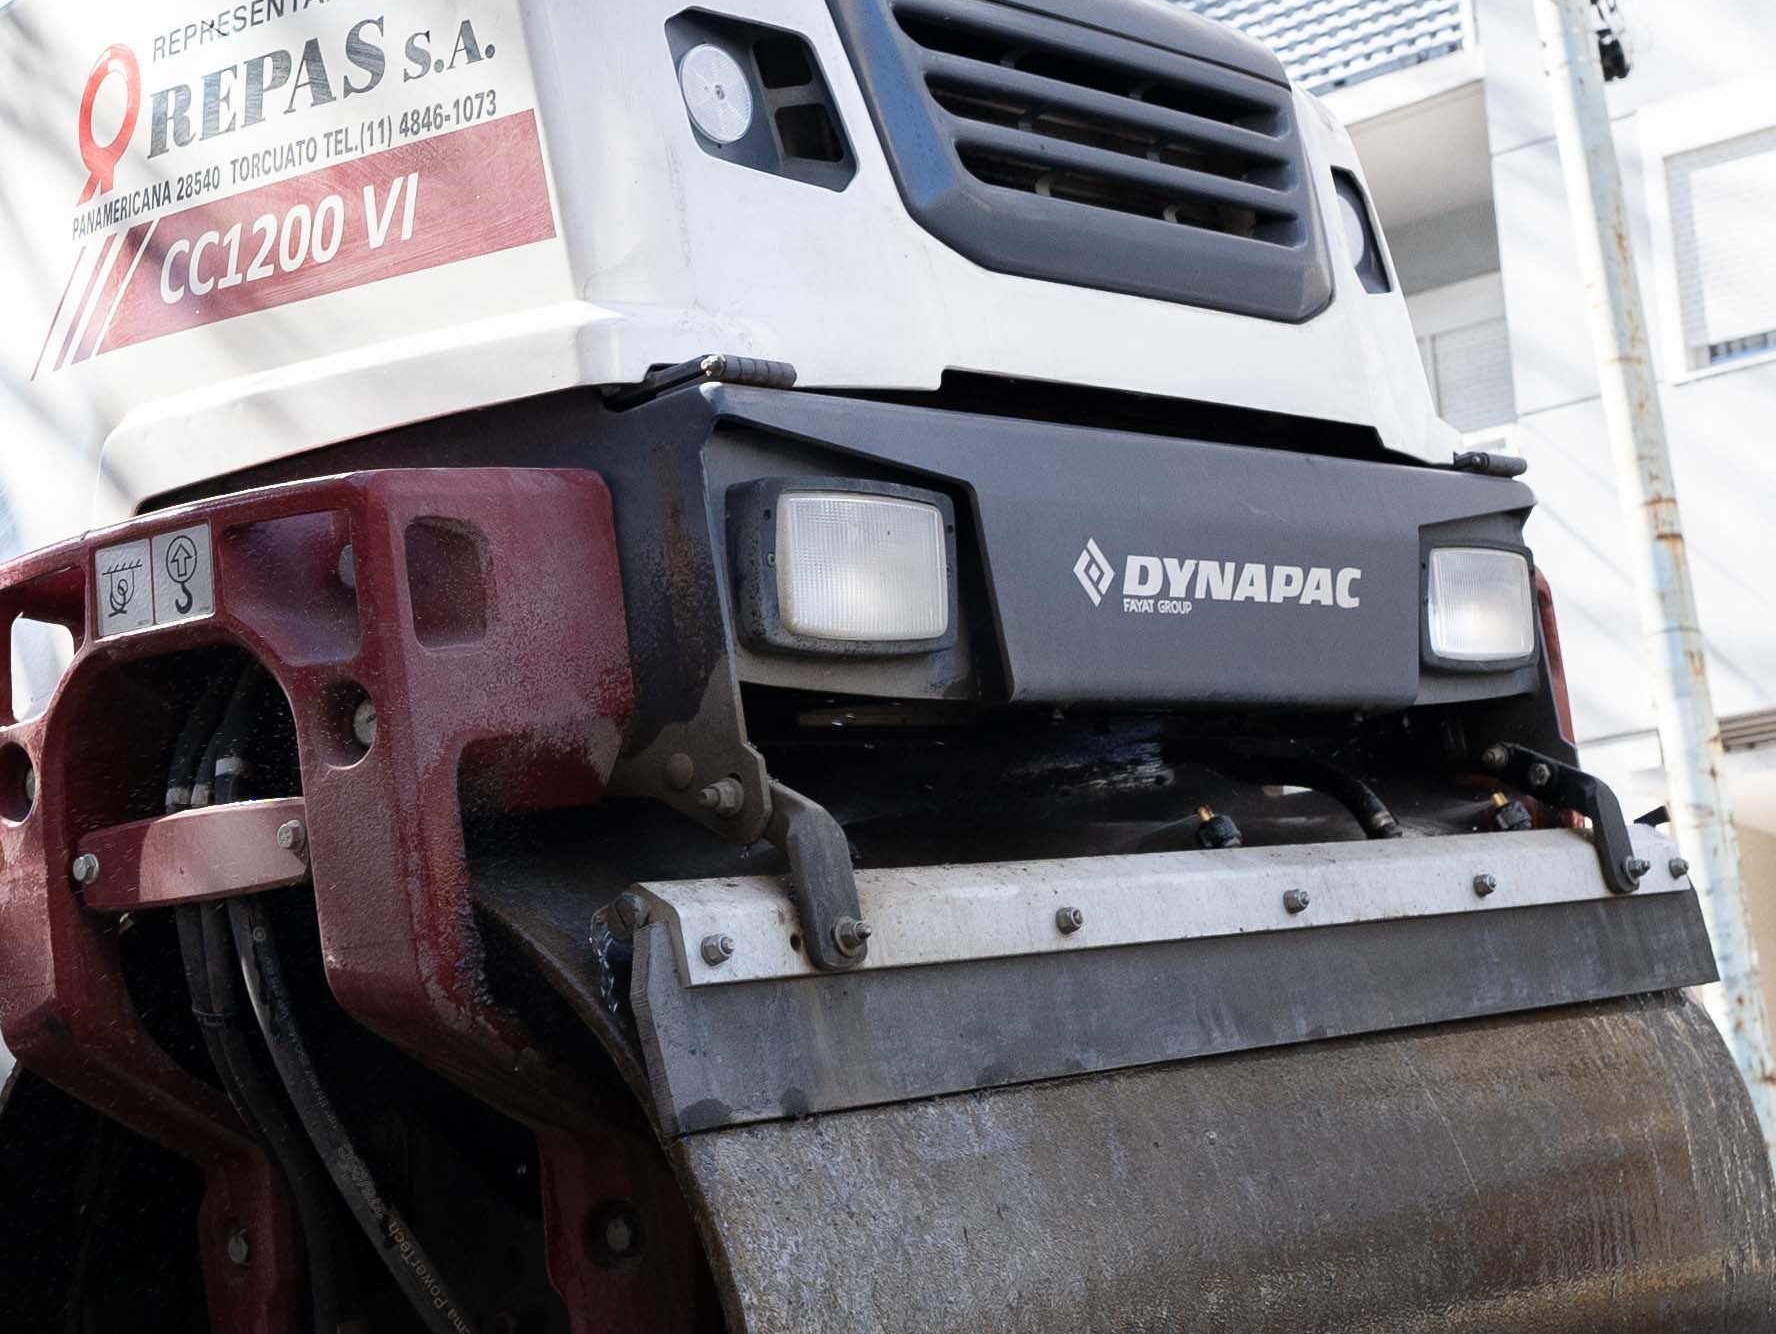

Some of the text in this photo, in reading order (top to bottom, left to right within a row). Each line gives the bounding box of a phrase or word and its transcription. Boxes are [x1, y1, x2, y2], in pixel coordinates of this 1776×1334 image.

[147, 15, 496, 160] REPAS S.A.
[72, 185, 172, 242] PANAMERICANA
[176, 165, 221, 203] 28540
[230, 139, 319, 185] TORCUATO
[399, 89, 498, 139] 4846-1073
[159, 173, 419, 305] CC1200 VI
[1123, 555, 1362, 609] DYNAPAC
[1124, 598, 1192, 615] FAYAT GROUP
